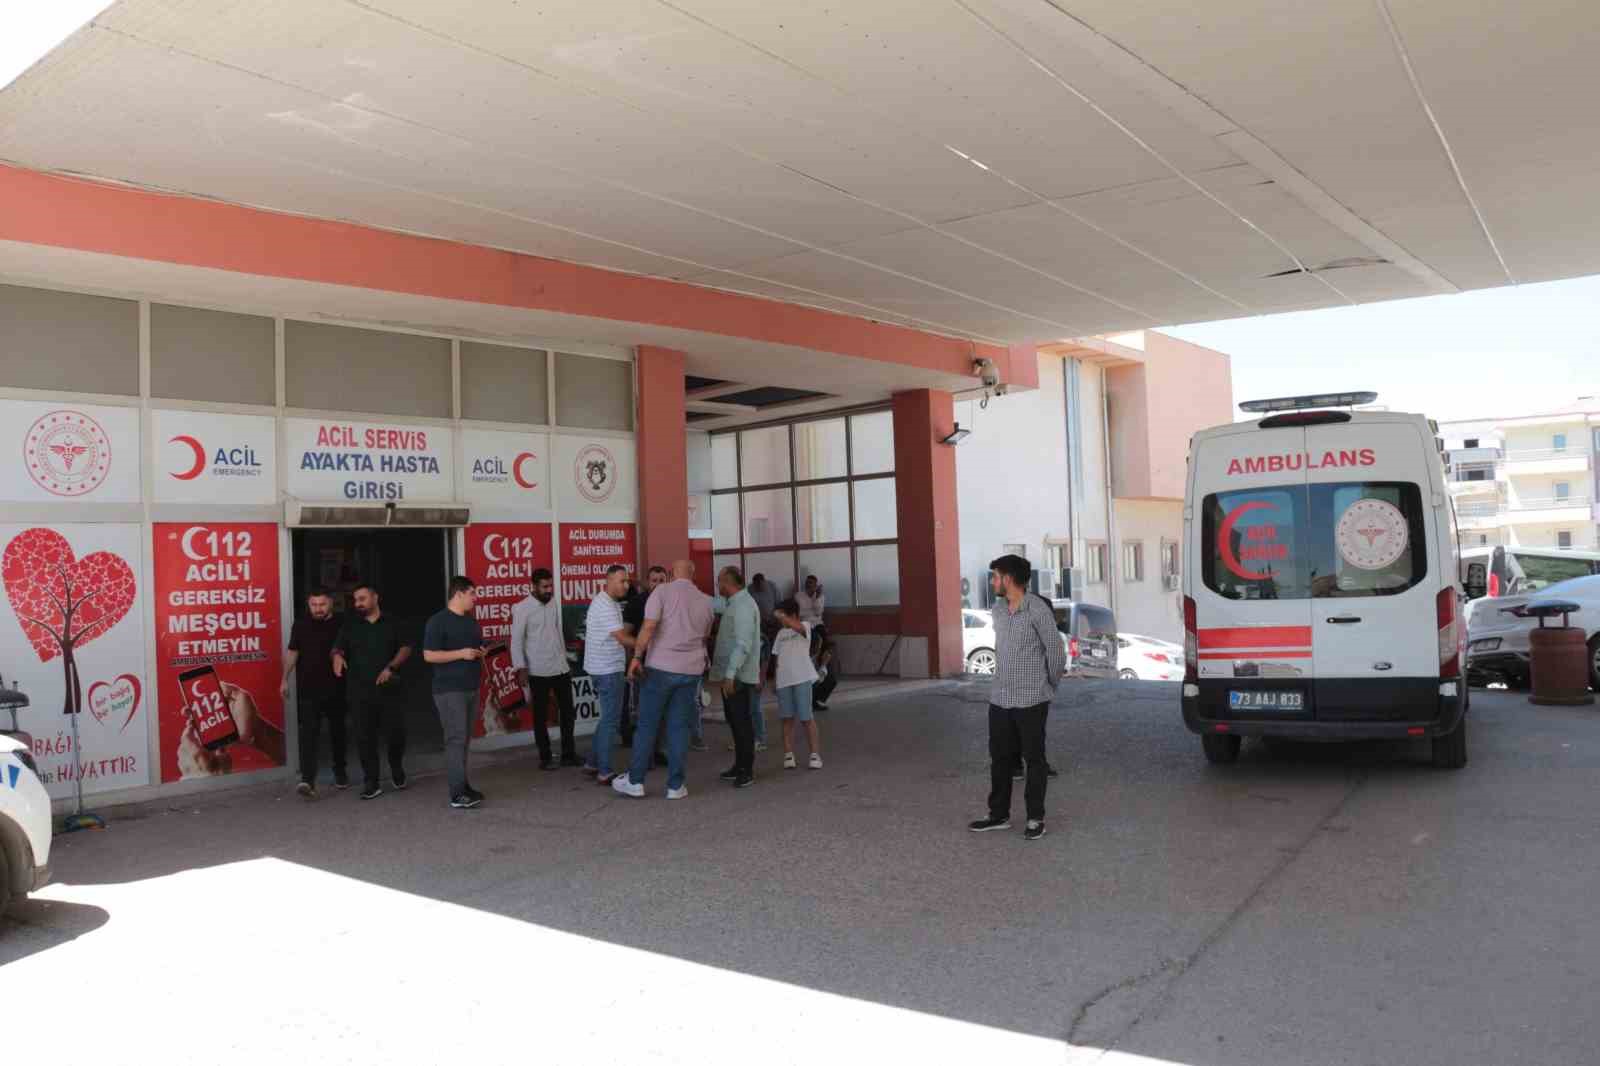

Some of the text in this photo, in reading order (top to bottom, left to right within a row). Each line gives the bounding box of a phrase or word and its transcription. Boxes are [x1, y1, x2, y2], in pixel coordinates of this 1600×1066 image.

[317, 425, 427, 450] ACİL SERVİS
[214, 444, 262, 466] ACİL
[301, 452, 440, 474] AYAKTA HASTA
[473, 456, 508, 474] ACİL
[1227, 448, 1376, 475] AMBULANS
[212, 468, 262, 477] EMERGENCY
[206, 532, 251, 557] 112
[500, 537, 533, 558] 112
[168, 585, 266, 606] GEREKSİZ
[562, 579, 608, 601] UNUT
[168, 612, 266, 636] MEŞGUL
[178, 635, 259, 655] ETMEYİN
[191, 692, 224, 718] 112
[34, 729, 82, 757] BAĞI
